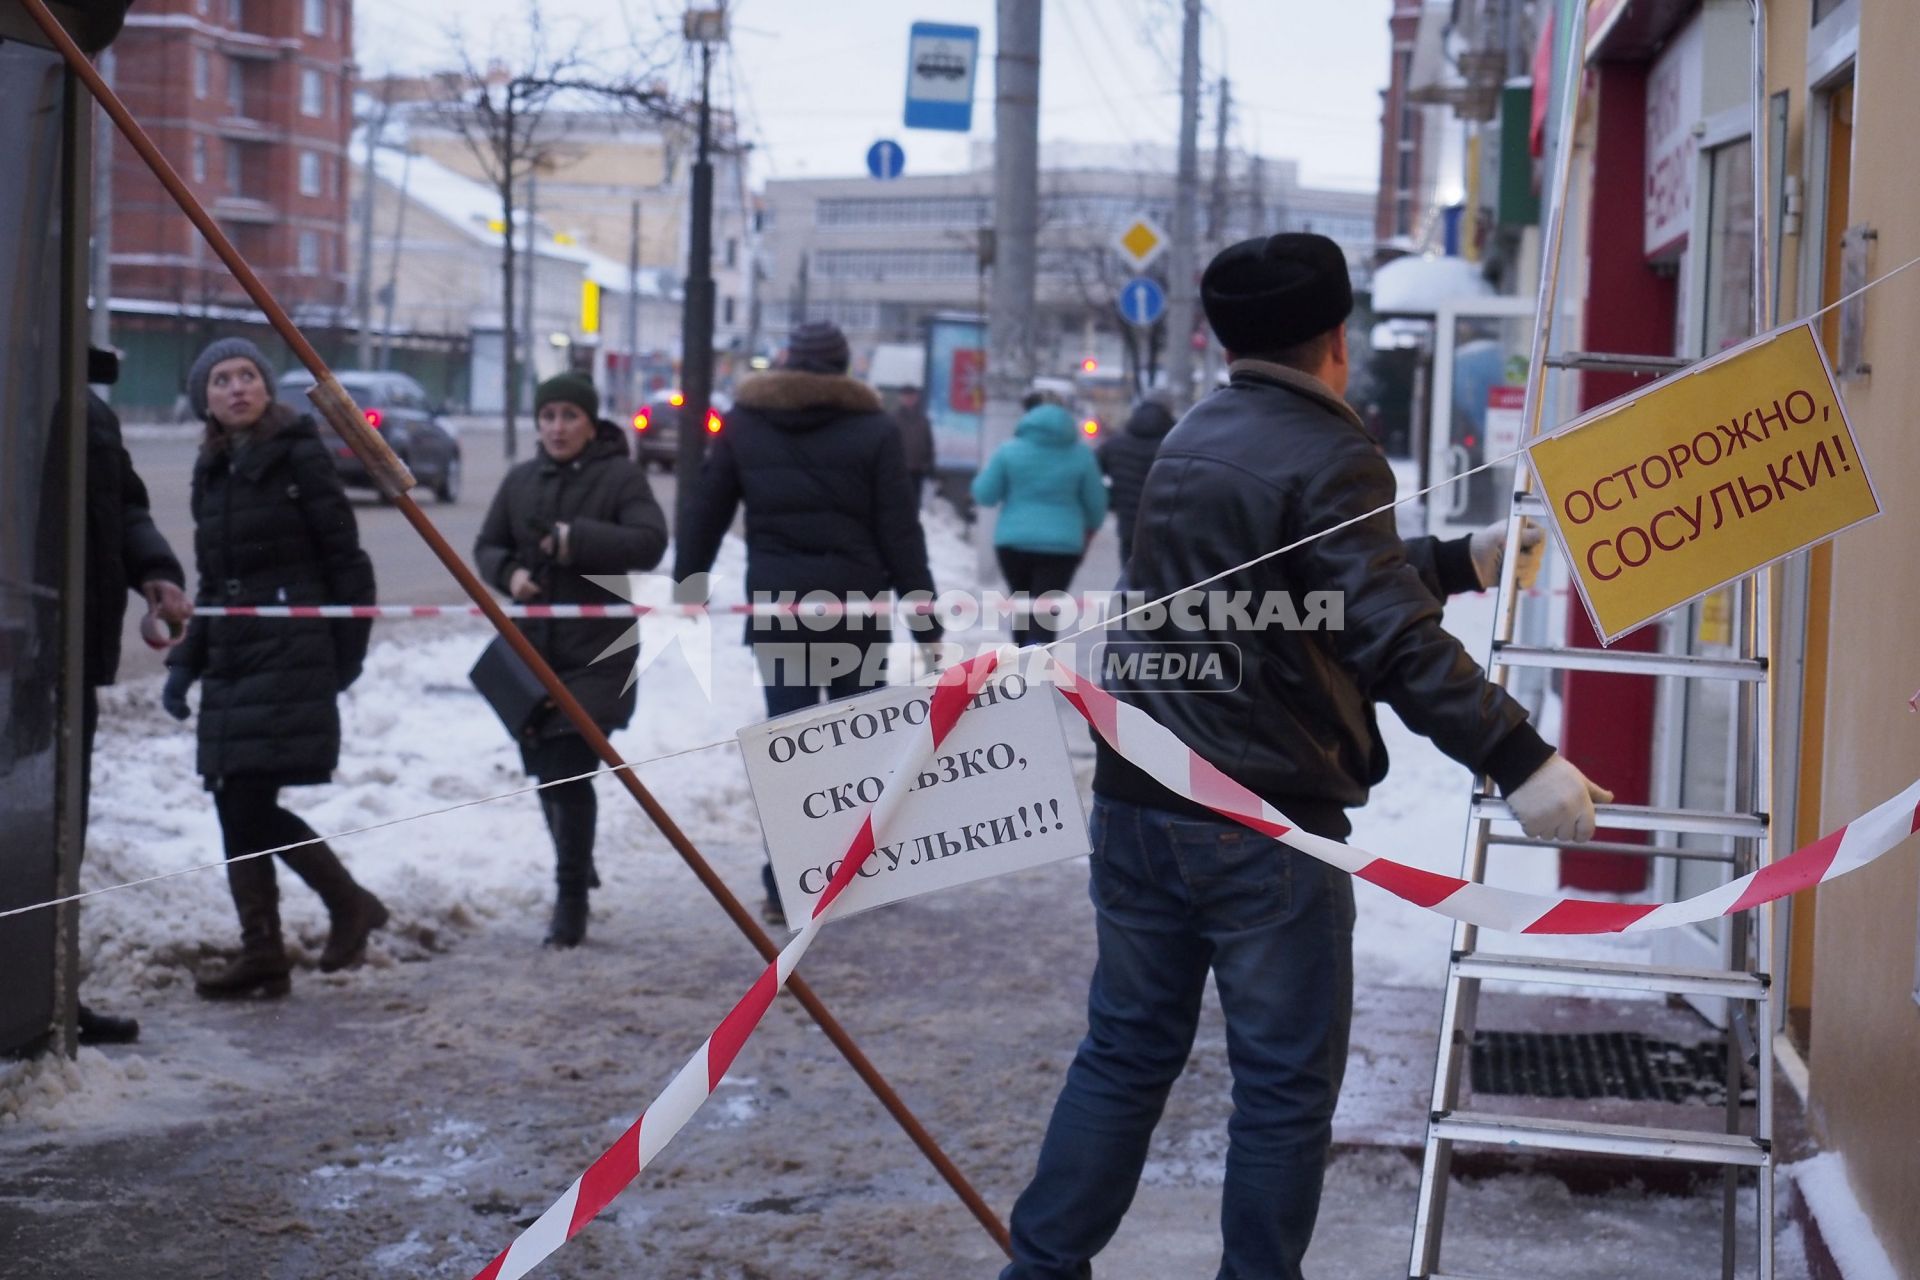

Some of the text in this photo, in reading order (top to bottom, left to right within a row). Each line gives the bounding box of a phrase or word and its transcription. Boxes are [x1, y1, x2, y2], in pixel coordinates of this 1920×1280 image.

[1564, 390, 1829, 525] ОСТОРОЖНО,
[1586, 434, 1850, 581] СОСУЛЬКИ!
[768, 673, 1028, 764] ОСТОРОНО
[802, 742, 1028, 820] СКОЬЗКО,
